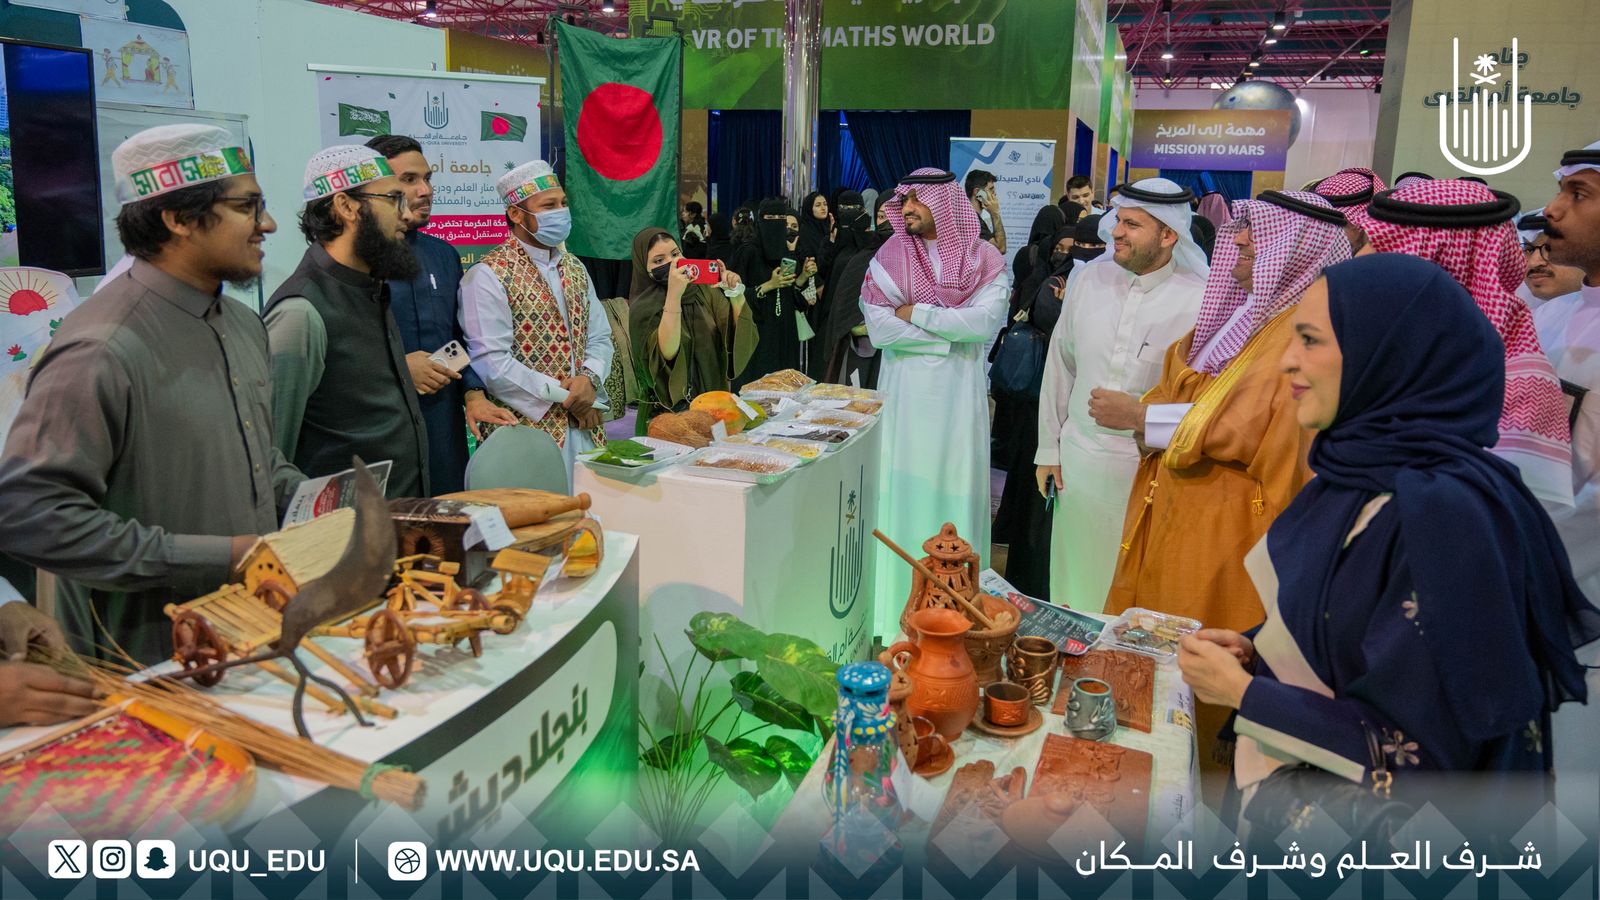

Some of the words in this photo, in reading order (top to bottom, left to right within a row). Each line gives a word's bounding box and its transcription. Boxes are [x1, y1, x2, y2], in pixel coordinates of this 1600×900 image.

[692, 29, 721, 49] VR
[727, 27, 757, 48] OF
[761, 27, 785, 48] TH
[901, 23, 995, 46] WORLD
[1155, 123, 1195, 138] المريخ
[1198, 124, 1223, 138] إلى
[1225, 123, 1266, 136] مهمة
[1154, 144, 1206, 155] MISSION
[1209, 144, 1226, 154] TO
[1228, 145, 1265, 156] MARS
[450, 159, 492, 177] جامعة
[1024, 176, 1041, 186] نادي
[454, 183, 477, 195] العلم
[480, 183, 495, 194] منار
[438, 219, 463, 230] تحتضن
[463, 218, 492, 229] المكرمة
[446, 230, 471, 241] مشرق
[472, 229, 503, 240] مستقبل
[438, 683, 588, 848] بنجلاديش
